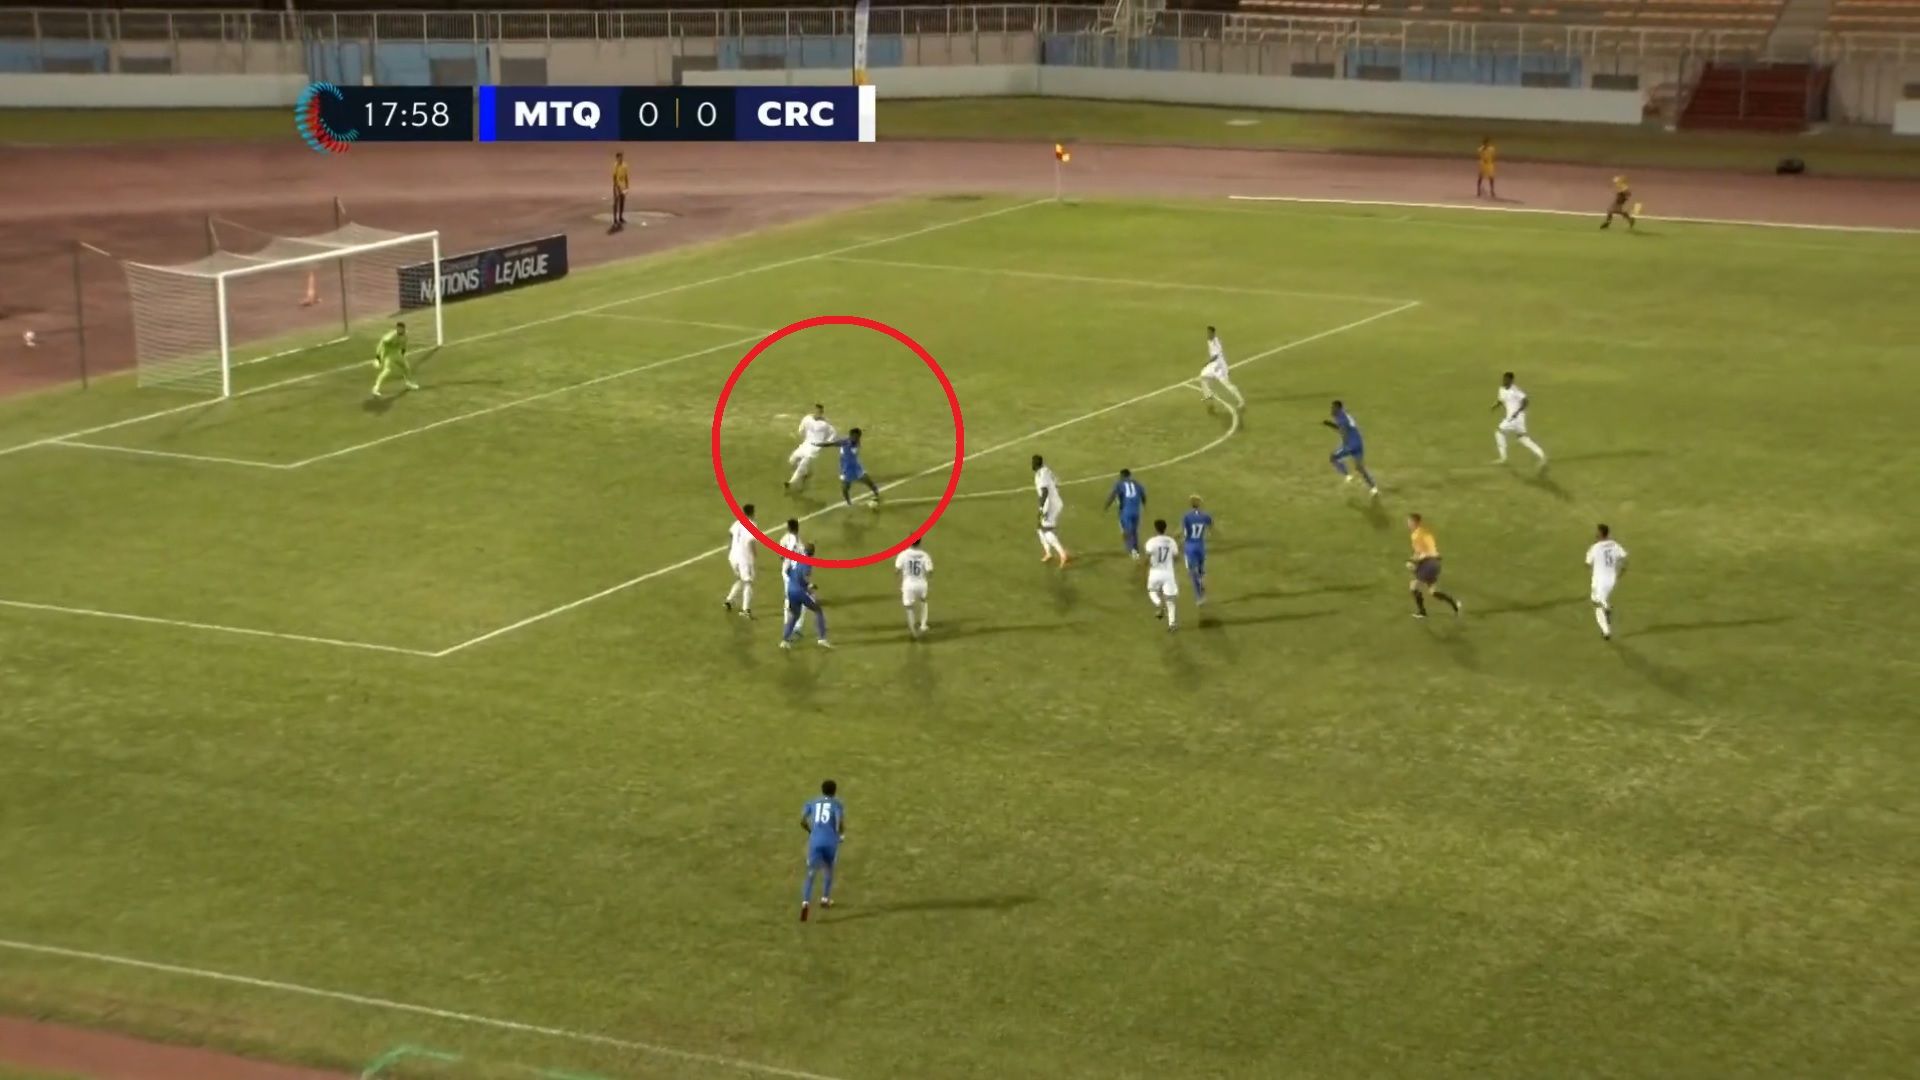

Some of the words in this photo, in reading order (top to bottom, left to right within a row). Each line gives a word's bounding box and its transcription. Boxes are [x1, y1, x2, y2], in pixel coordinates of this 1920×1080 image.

[495, 254, 549, 285] LEAGUE
[1124, 481, 1137, 498] 11
[1191, 523, 1204, 539] 17
[1158, 546, 1170, 563] 17
[908, 560, 921, 577] 16
[814, 802, 831, 824] 15
